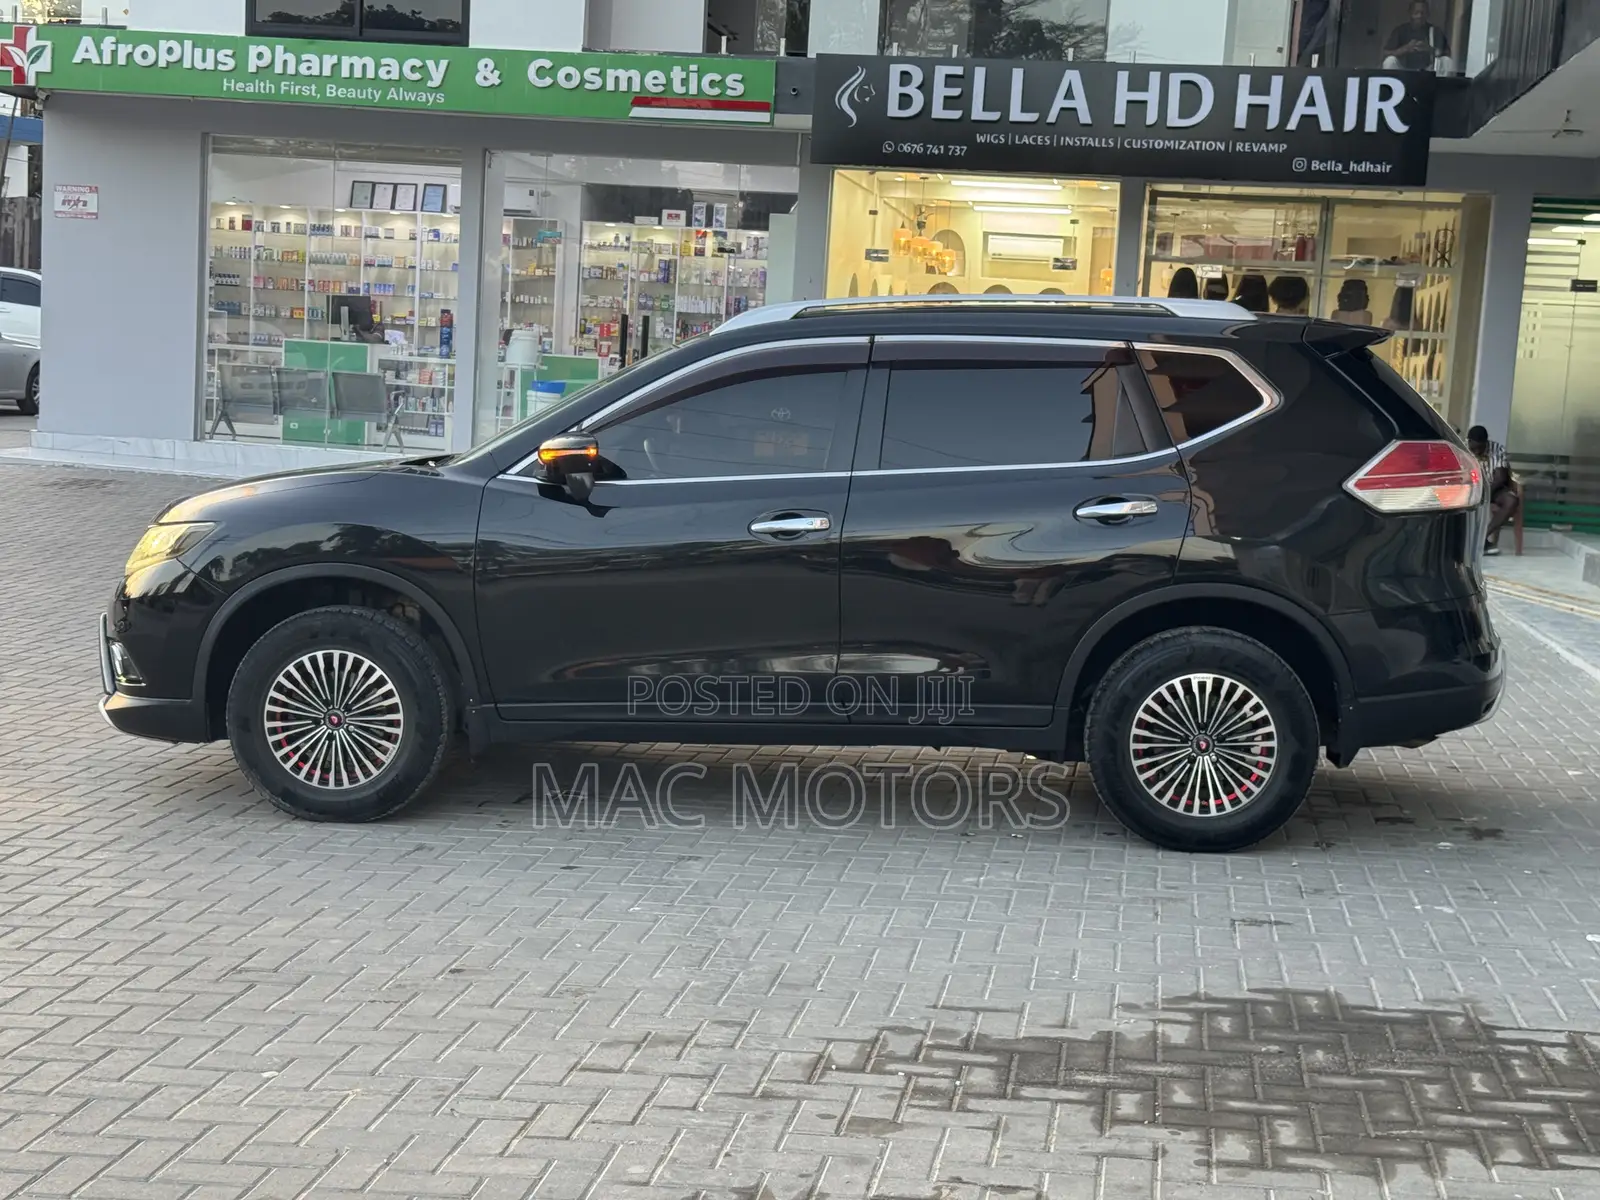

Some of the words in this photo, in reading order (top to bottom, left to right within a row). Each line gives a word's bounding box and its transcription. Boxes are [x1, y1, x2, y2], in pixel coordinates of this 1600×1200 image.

[475, 57, 501, 87] &
[527, 59, 745, 97] Cosmetics
[223, 78, 275, 94] Health
[280, 81, 320, 99] First,
[326, 84, 381, 102] Beauty
[387, 87, 445, 106] Always
[886, 63, 1092, 126] BELLA
[1113, 70, 1214, 128] HD
[1233, 74, 1410, 134] HAIR
[897, 143, 924, 154] 0676
[926, 144, 944, 155] 741
[948, 145, 967, 157] 737
[976, 133, 1005, 144] WIGS
[1015, 135, 1050, 146] LACES
[1060, 136, 1114, 148] INSTALLS
[1124, 138, 1225, 152] CUSTOMIZATION
[1236, 142, 1288, 154] REVAMP
[1311, 160, 1393, 175] Bella_hdhair
